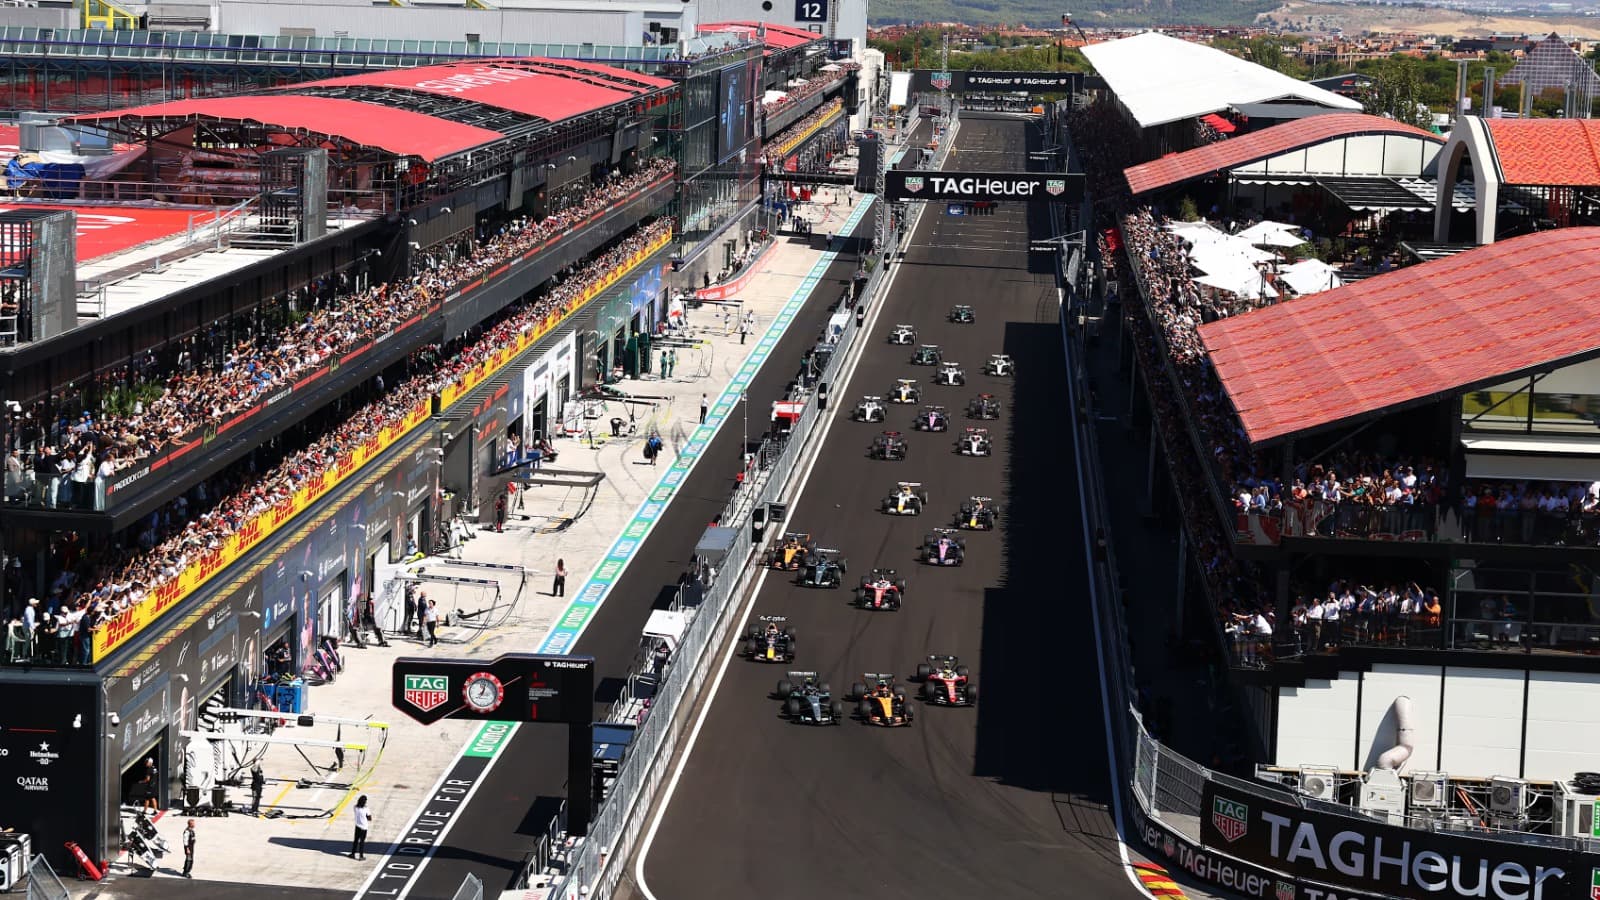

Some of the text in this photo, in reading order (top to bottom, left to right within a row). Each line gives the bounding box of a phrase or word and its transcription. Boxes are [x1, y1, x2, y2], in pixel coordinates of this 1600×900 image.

[802, 3, 821, 18] 12
[930, 177, 1040, 196] TAGHeuer
[408, 677, 444, 690] TAG
[407, 691, 446, 709] HEUER
[16, 776, 48, 786] QATAR
[1218, 800, 1245, 820] TAG
[380, 862, 415, 879] TO
[398, 810, 452, 854] DRIVE
[434, 779, 473, 803] FOR
[1215, 815, 1246, 839] HEUER
[1262, 811, 1566, 900] TAGHeuer
[1178, 842, 1271, 897] TAGHeuer
